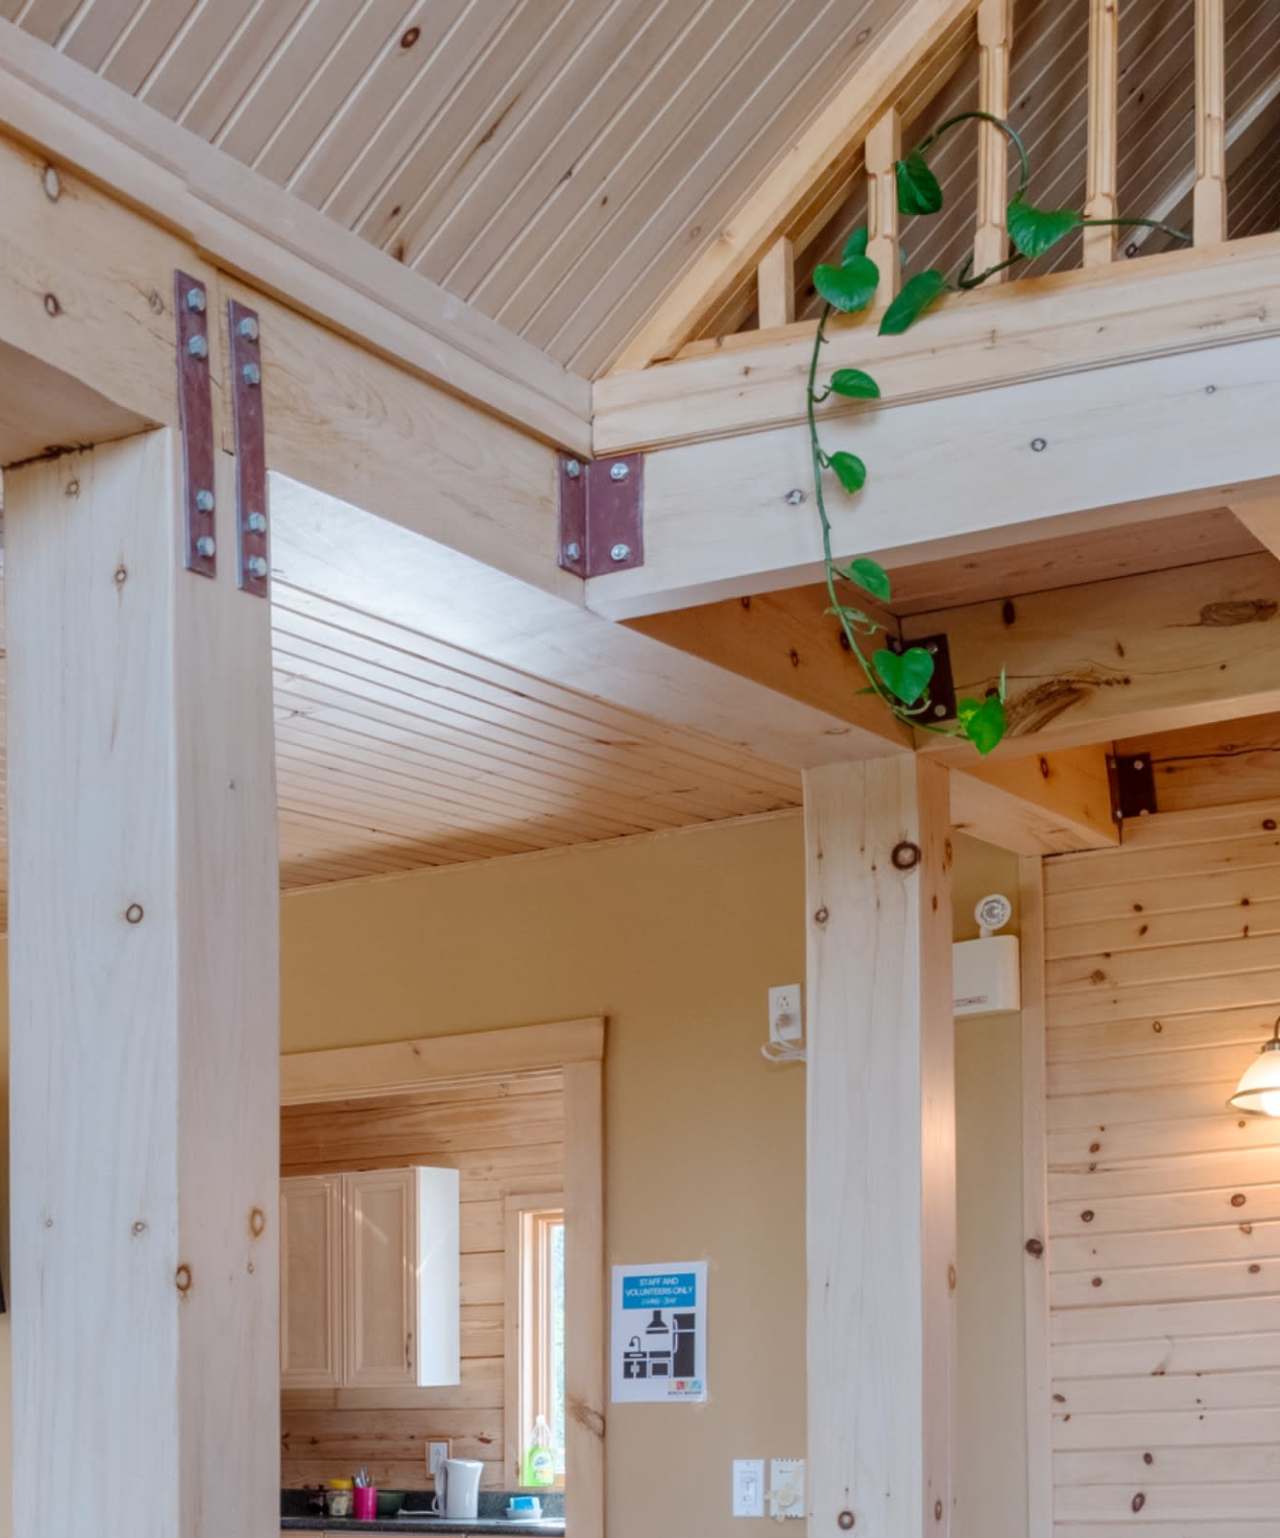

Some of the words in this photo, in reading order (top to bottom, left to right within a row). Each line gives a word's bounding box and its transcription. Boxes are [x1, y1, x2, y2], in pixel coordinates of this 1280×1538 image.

[662, 1276, 679, 1285] AND
[625, 1287, 672, 1296] VOLUNTEERS
[672, 1286, 693, 1295] ONLY
